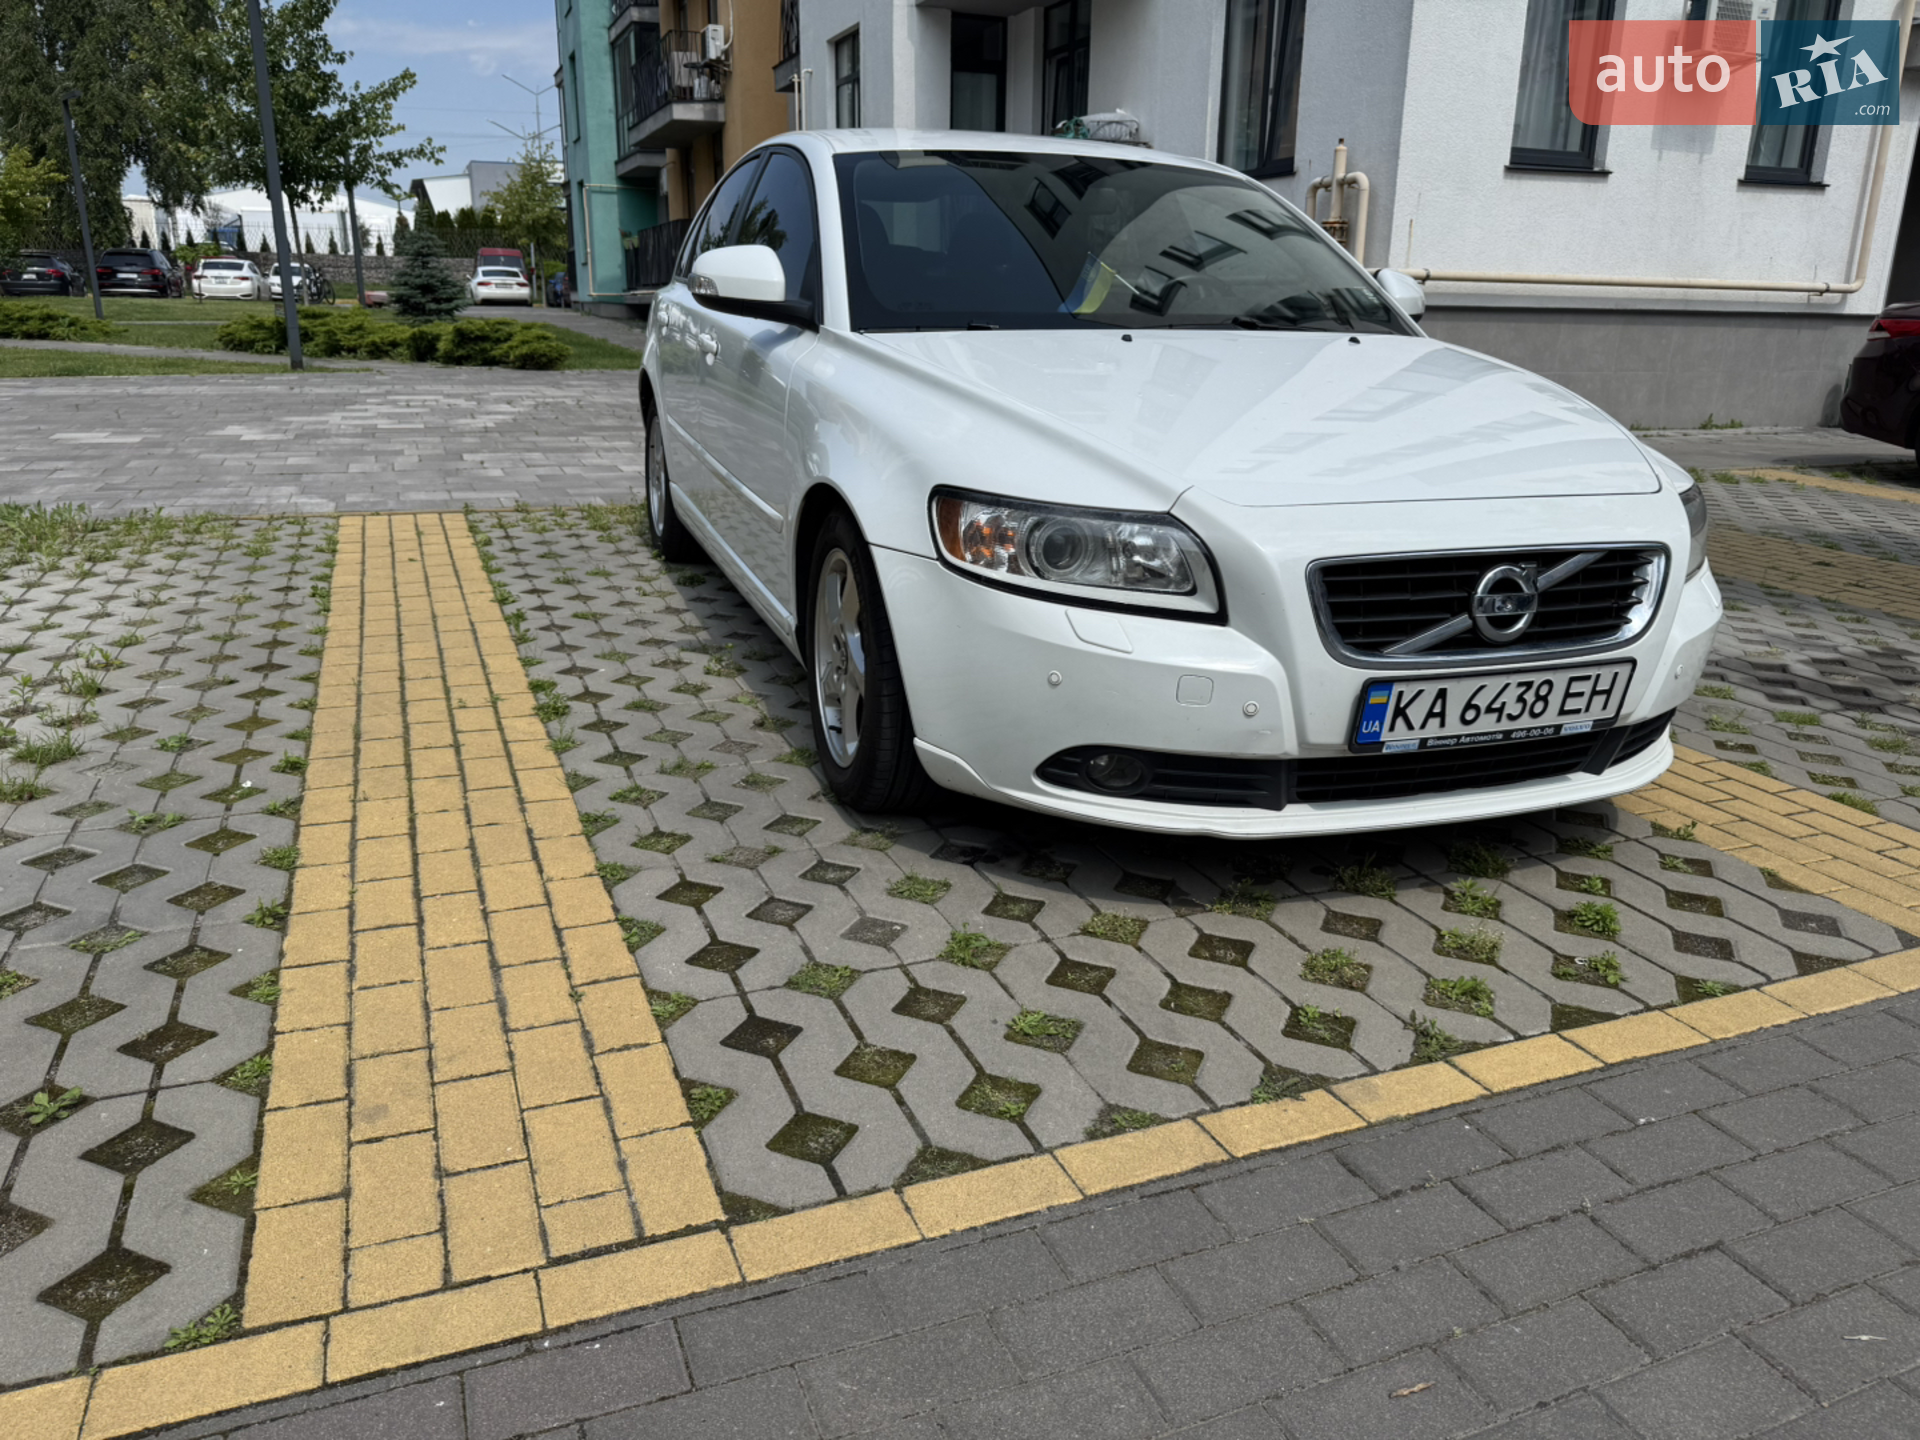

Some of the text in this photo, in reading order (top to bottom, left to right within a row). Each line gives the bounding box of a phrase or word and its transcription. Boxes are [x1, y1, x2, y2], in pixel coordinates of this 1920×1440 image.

[1388, 671, 1620, 733] KA 6438 EH
[1361, 720, 1380, 734] UA
